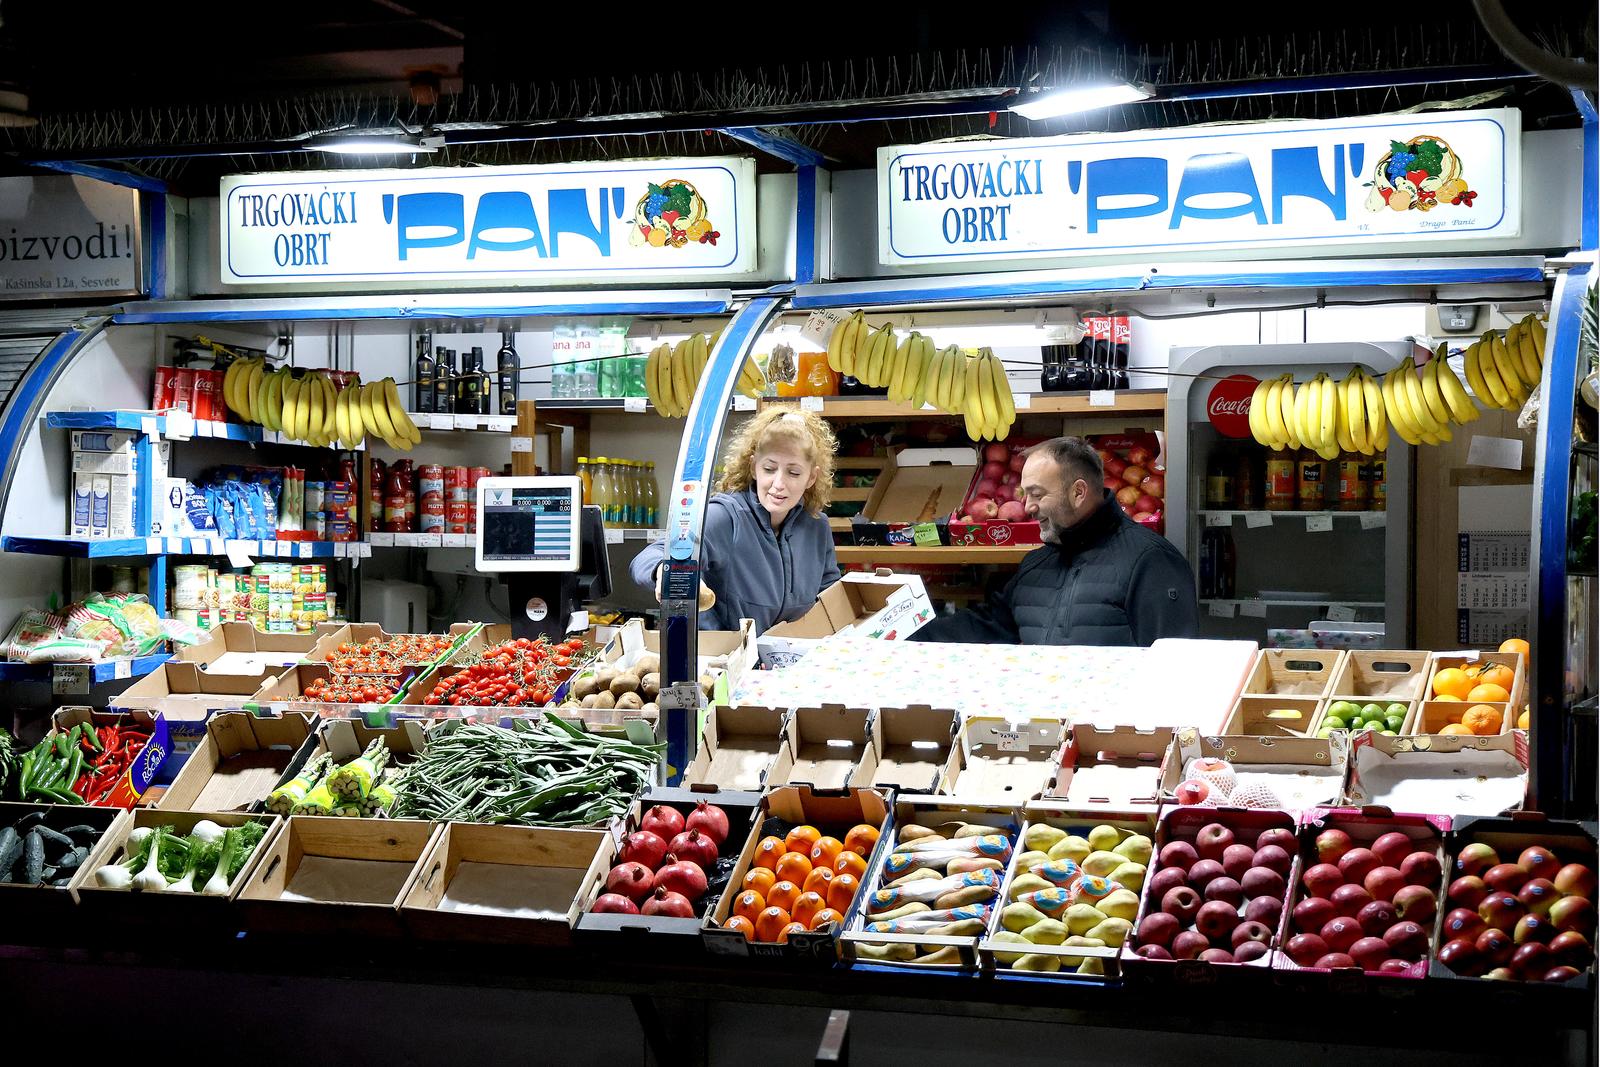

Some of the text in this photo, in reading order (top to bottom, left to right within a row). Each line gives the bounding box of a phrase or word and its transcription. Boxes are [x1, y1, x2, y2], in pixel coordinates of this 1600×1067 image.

[900, 154, 1043, 202] TRGOVAČKI
[238, 186, 358, 228] TRGOVAČKI
[942, 204, 1011, 244] OBRT
[1419, 220, 1446, 230] Drago
[273, 232, 331, 267] OBRT
[5, 277, 52, 289] Kašinska
[80, 276, 121, 288] Sesvete
